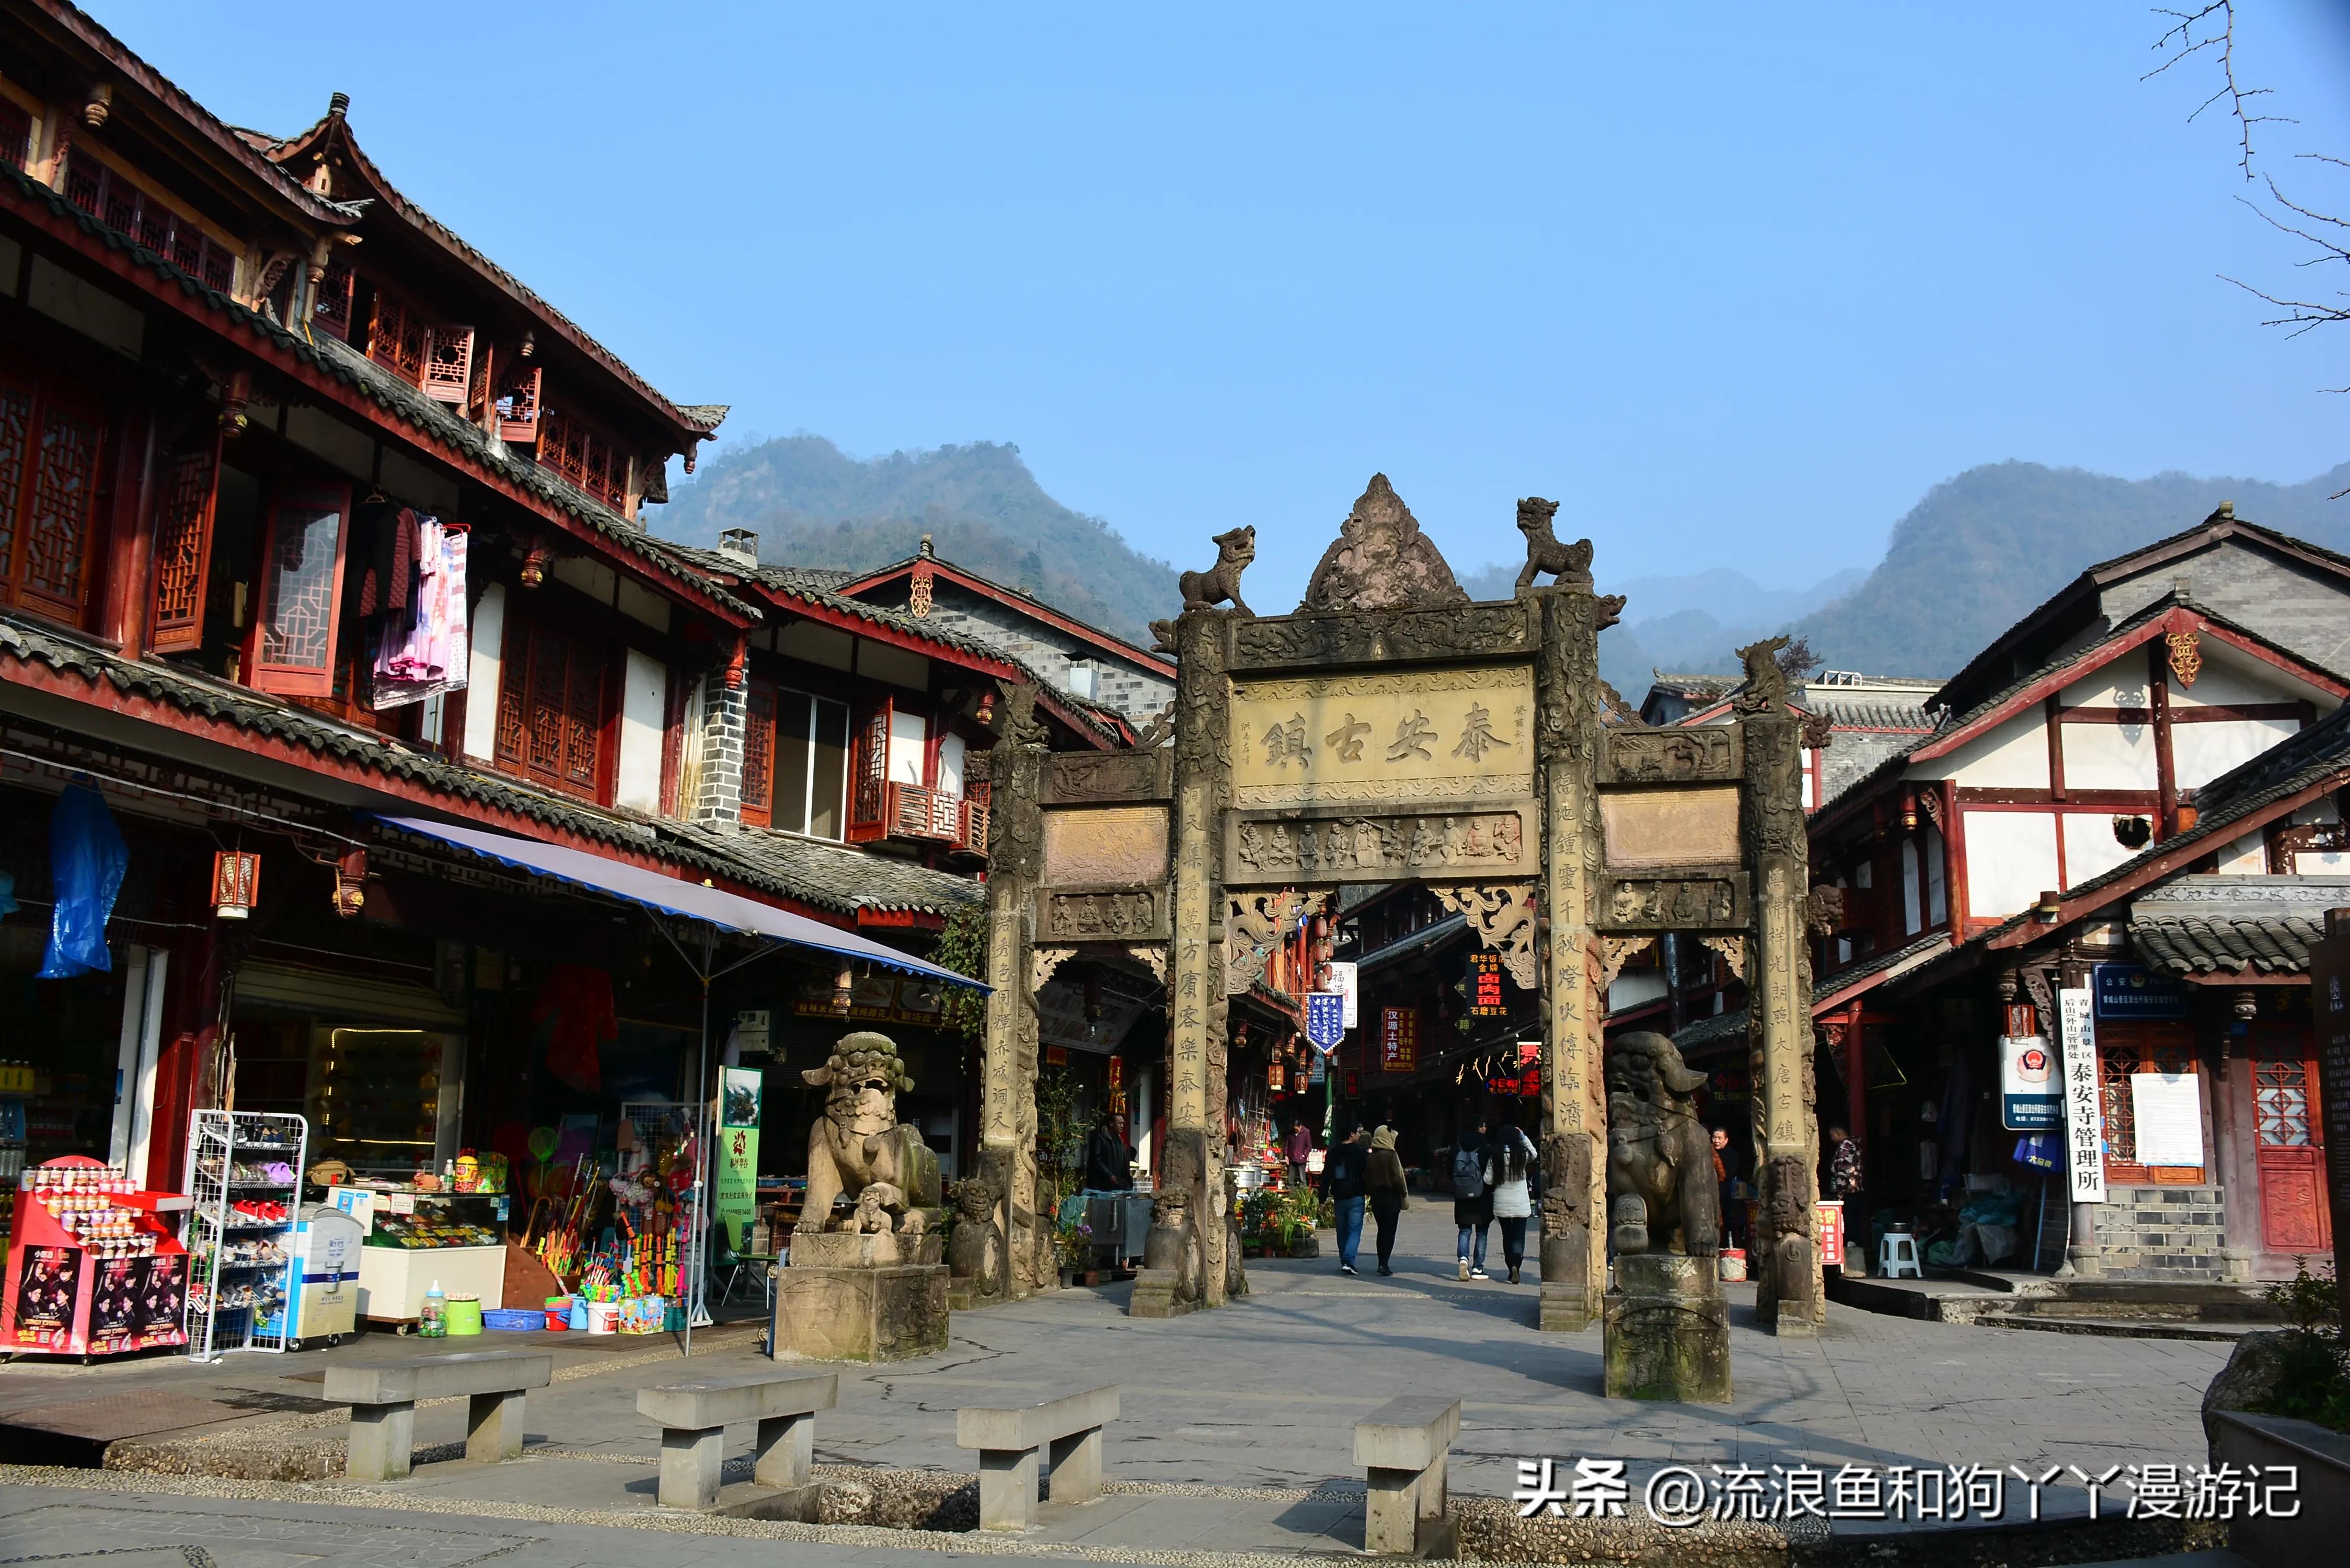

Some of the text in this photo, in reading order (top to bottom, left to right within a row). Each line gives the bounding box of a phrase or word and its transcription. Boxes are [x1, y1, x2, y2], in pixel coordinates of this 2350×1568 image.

[1478, 964, 1499, 972] 金牌
[2105, 977, 2126, 986] 公安
[1477, 973, 1502, 1005] 卤肉面
[1470, 1007, 1508, 1016] 石磨豆花
[1387, 1011, 1398, 1062] 汉源土特产
[2079, 999, 2093, 1059] 青城山景区
[2071, 1063, 2100, 1191] 泰安寺管理所
